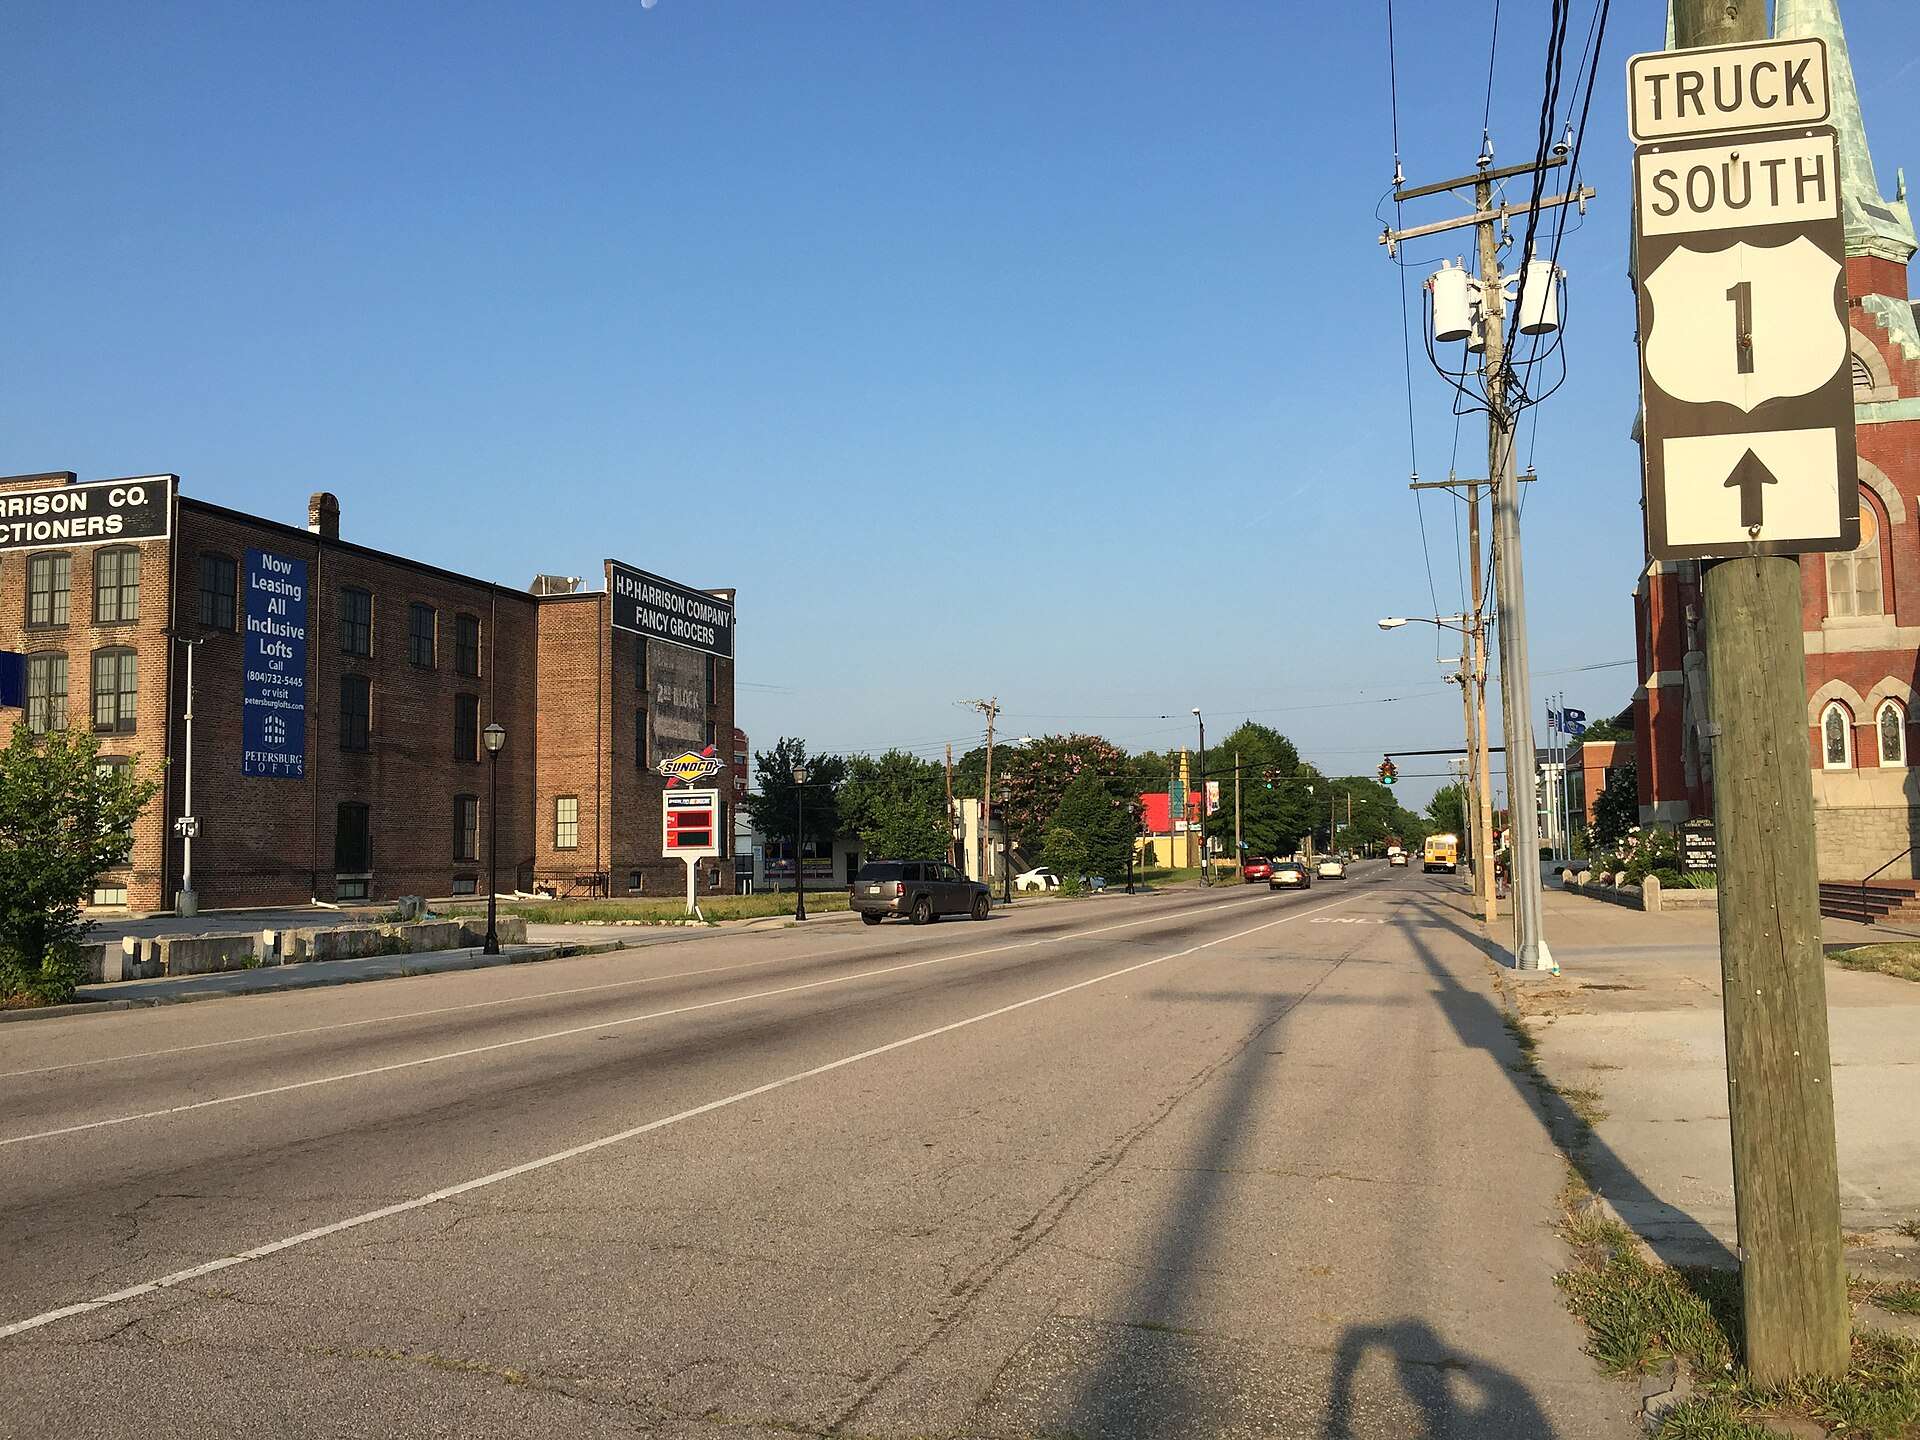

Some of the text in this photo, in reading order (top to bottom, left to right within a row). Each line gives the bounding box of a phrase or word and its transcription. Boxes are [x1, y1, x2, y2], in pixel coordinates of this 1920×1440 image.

[1644, 58, 1815, 121] TRUCK
[1651, 154, 1826, 217] SOUTH
[1726, 281, 1755, 374] 1
[108, 486, 149, 508] CO.
[262, 553, 292, 575] Now
[251, 572, 302, 602] Leasing
[267, 597, 286, 616] All
[686, 599, 730, 628] COMPANY
[247, 614, 305, 640] Inclusive
[635, 606, 715, 645] FANCY GROCERS
[260, 638, 293, 659] Lofts
[268, 659, 284, 671] Call
[246, 670, 304, 688] (804)732-5445
[261, 687, 289, 699] or visit
[244, 697, 305, 711] petersburglofts.com
[244, 761, 303, 775] LOFTS
[245, 750, 303, 765] PETERSBURG
[664, 761, 714, 773] SUNOCO
